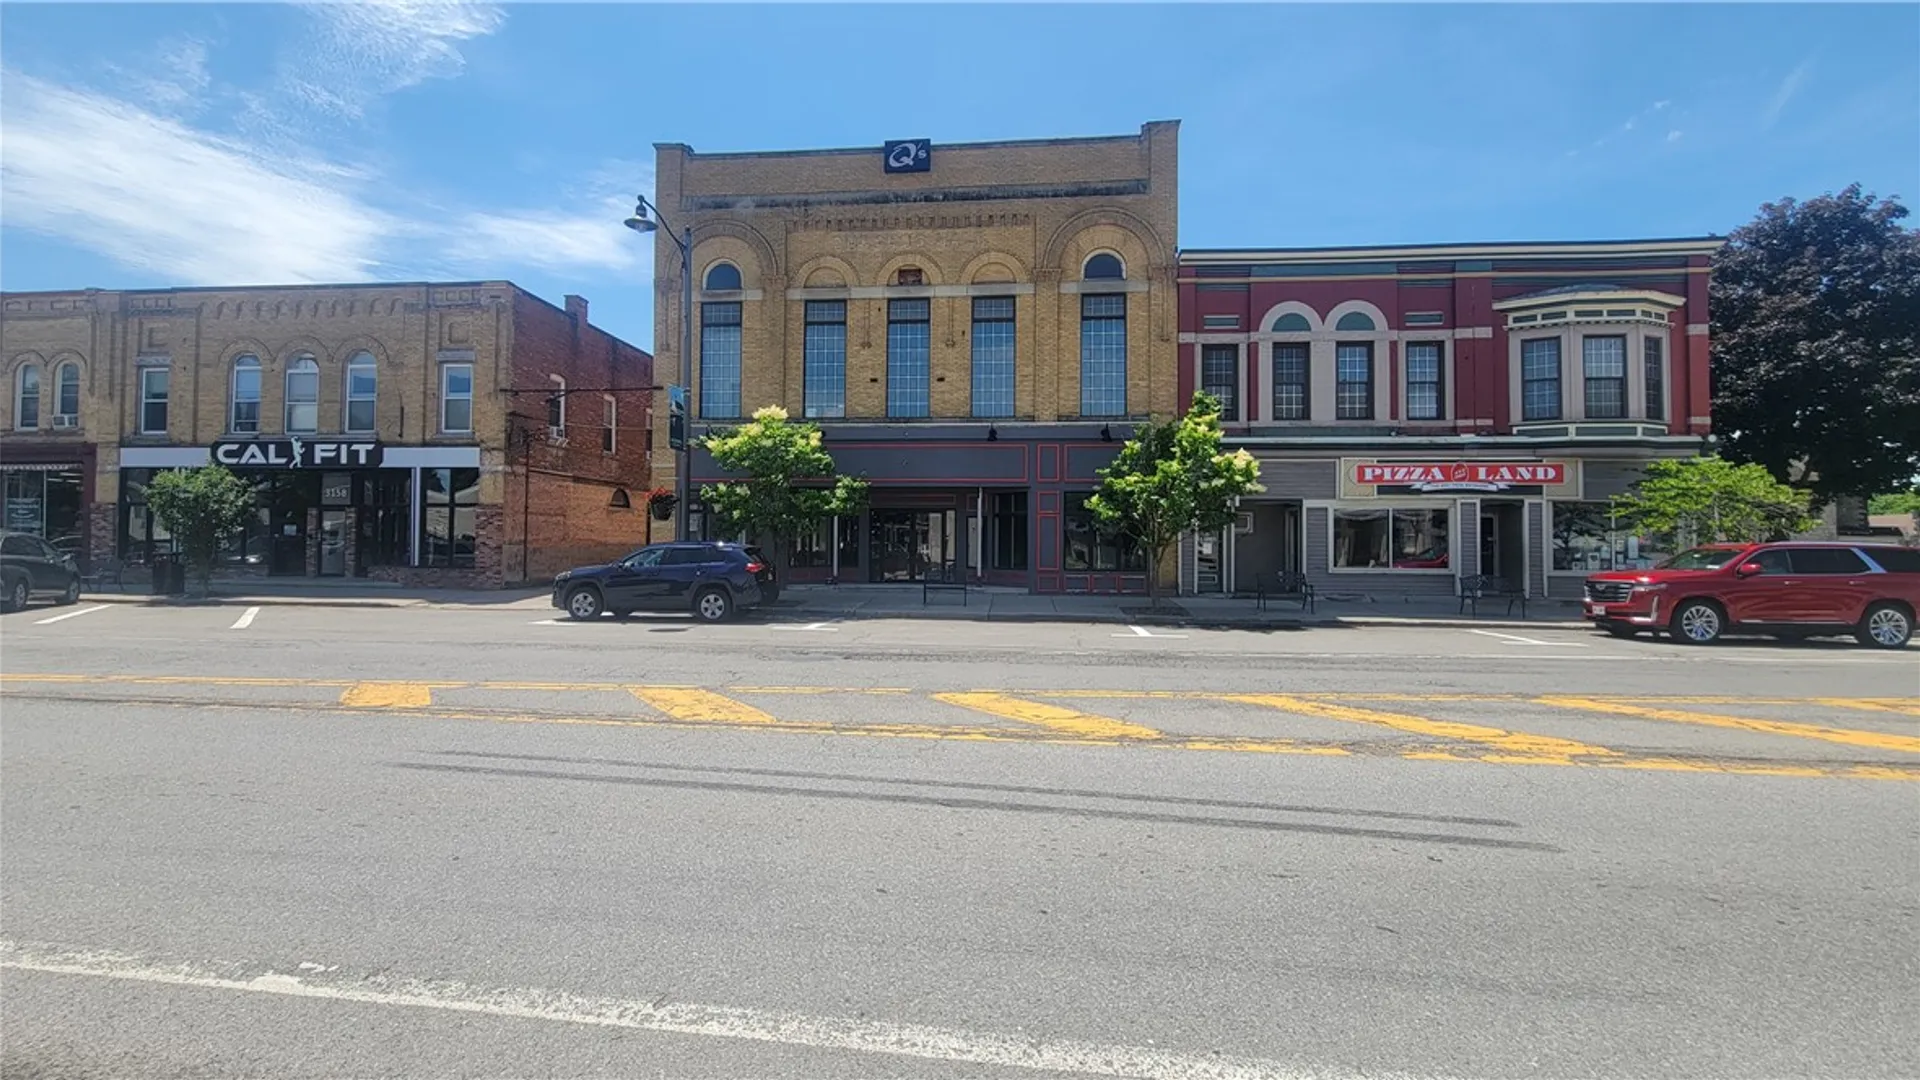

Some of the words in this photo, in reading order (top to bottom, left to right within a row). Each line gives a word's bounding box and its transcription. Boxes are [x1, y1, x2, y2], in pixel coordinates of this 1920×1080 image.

[889, 142, 927, 168] Q's
[216, 443, 288, 465] CAL
[313, 443, 375, 465] FIT
[1363, 466, 1445, 481] PIZZA
[1477, 466, 1556, 481] LAND
